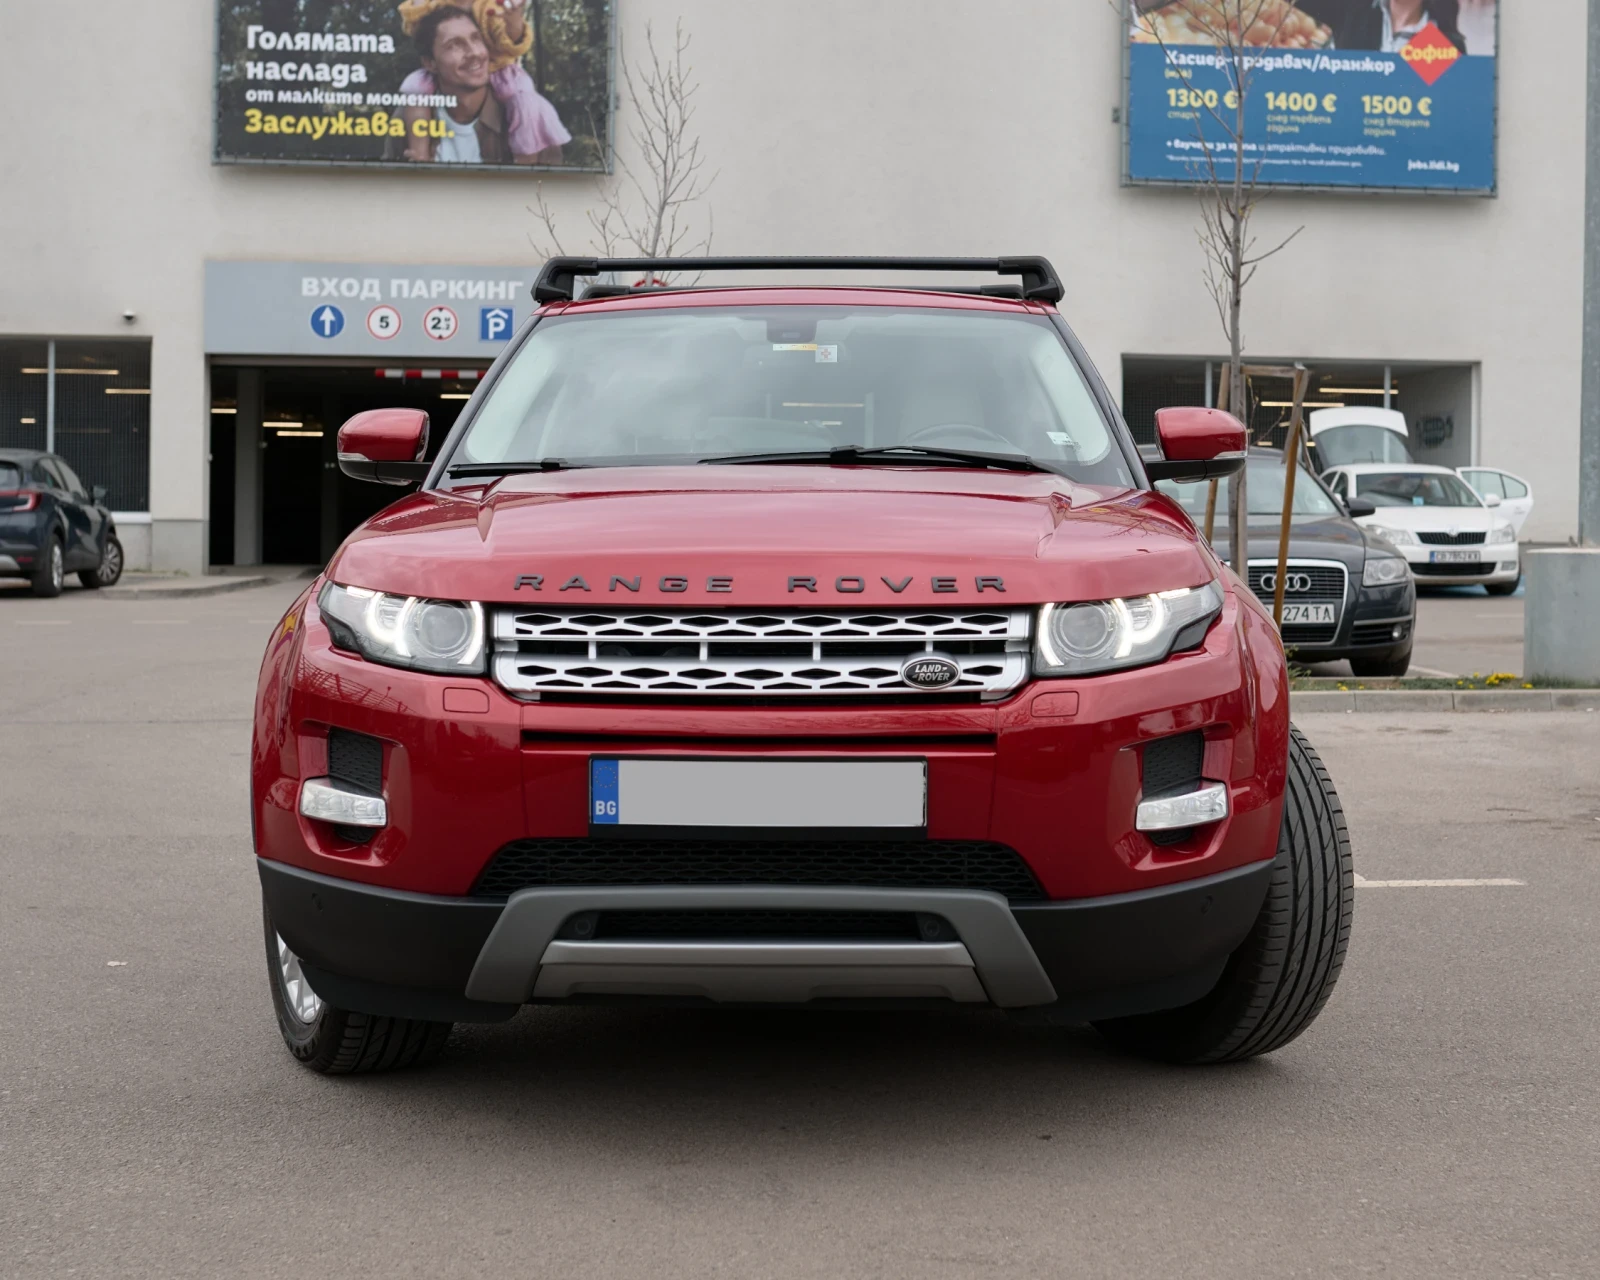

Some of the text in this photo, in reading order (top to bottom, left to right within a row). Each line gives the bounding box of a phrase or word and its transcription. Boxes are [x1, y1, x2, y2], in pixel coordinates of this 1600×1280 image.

[246, 25, 395, 53] Голямата
[1400, 43, 1459, 65] София
[246, 61, 367, 88] наслада
[245, 88, 457, 108] от малките моменти
[1166, 88, 1239, 109] 1300 €
[1265, 91, 1338, 113] 1400 €
[1361, 95, 1432, 116] 1500 €
[244, 108, 455, 141] Заслужава си.
[1227, 142, 1257, 152] хрна
[301, 277, 524, 301] ВХОД ПАРКИНГ
[379, 316, 390, 329] 5
[488, 317, 506, 340] P
[513, 573, 1008, 594] RANGE ROVER
[1281, 606, 1332, 621] 274 TA
[915, 664, 942, 673] LAND
[917, 672, 951, 682] ROVER
[594, 800, 617, 815] BG
